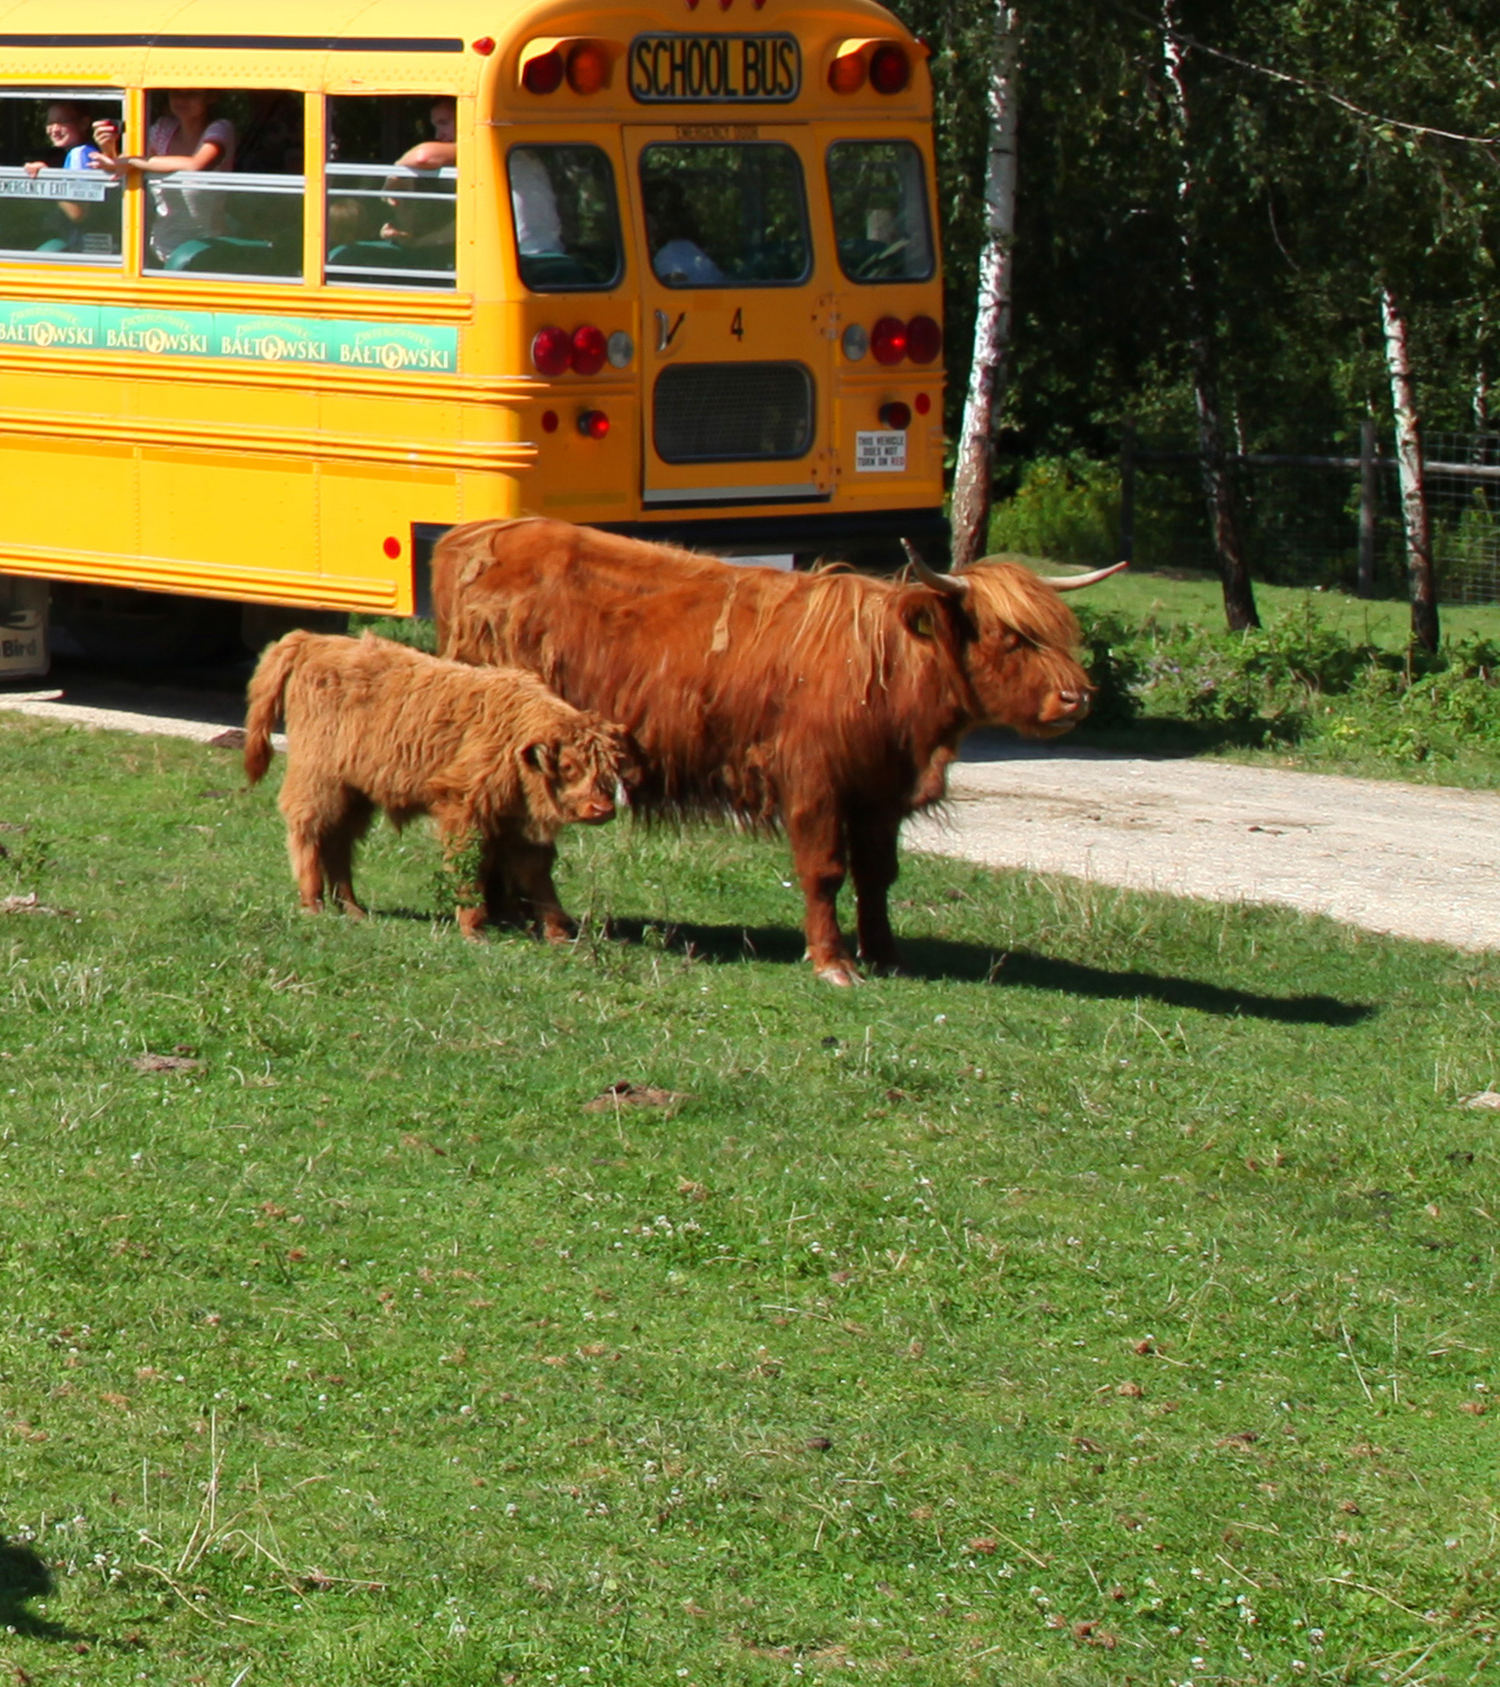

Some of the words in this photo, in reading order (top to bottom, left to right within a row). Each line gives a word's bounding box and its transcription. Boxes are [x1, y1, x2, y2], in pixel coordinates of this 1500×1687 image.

[635, 39, 739, 97] SCHOOL
[742, 39, 795, 97] BUS
[49, 181, 68, 196] EXIT
[730, 306, 744, 343] 4
[106, 327, 208, 354] BAŁTOWSKI
[221, 334, 327, 362] BAŁTOWSKI
[340, 342, 449, 370] BAŁTOWSKI
[2, 638, 37, 658] Bird
